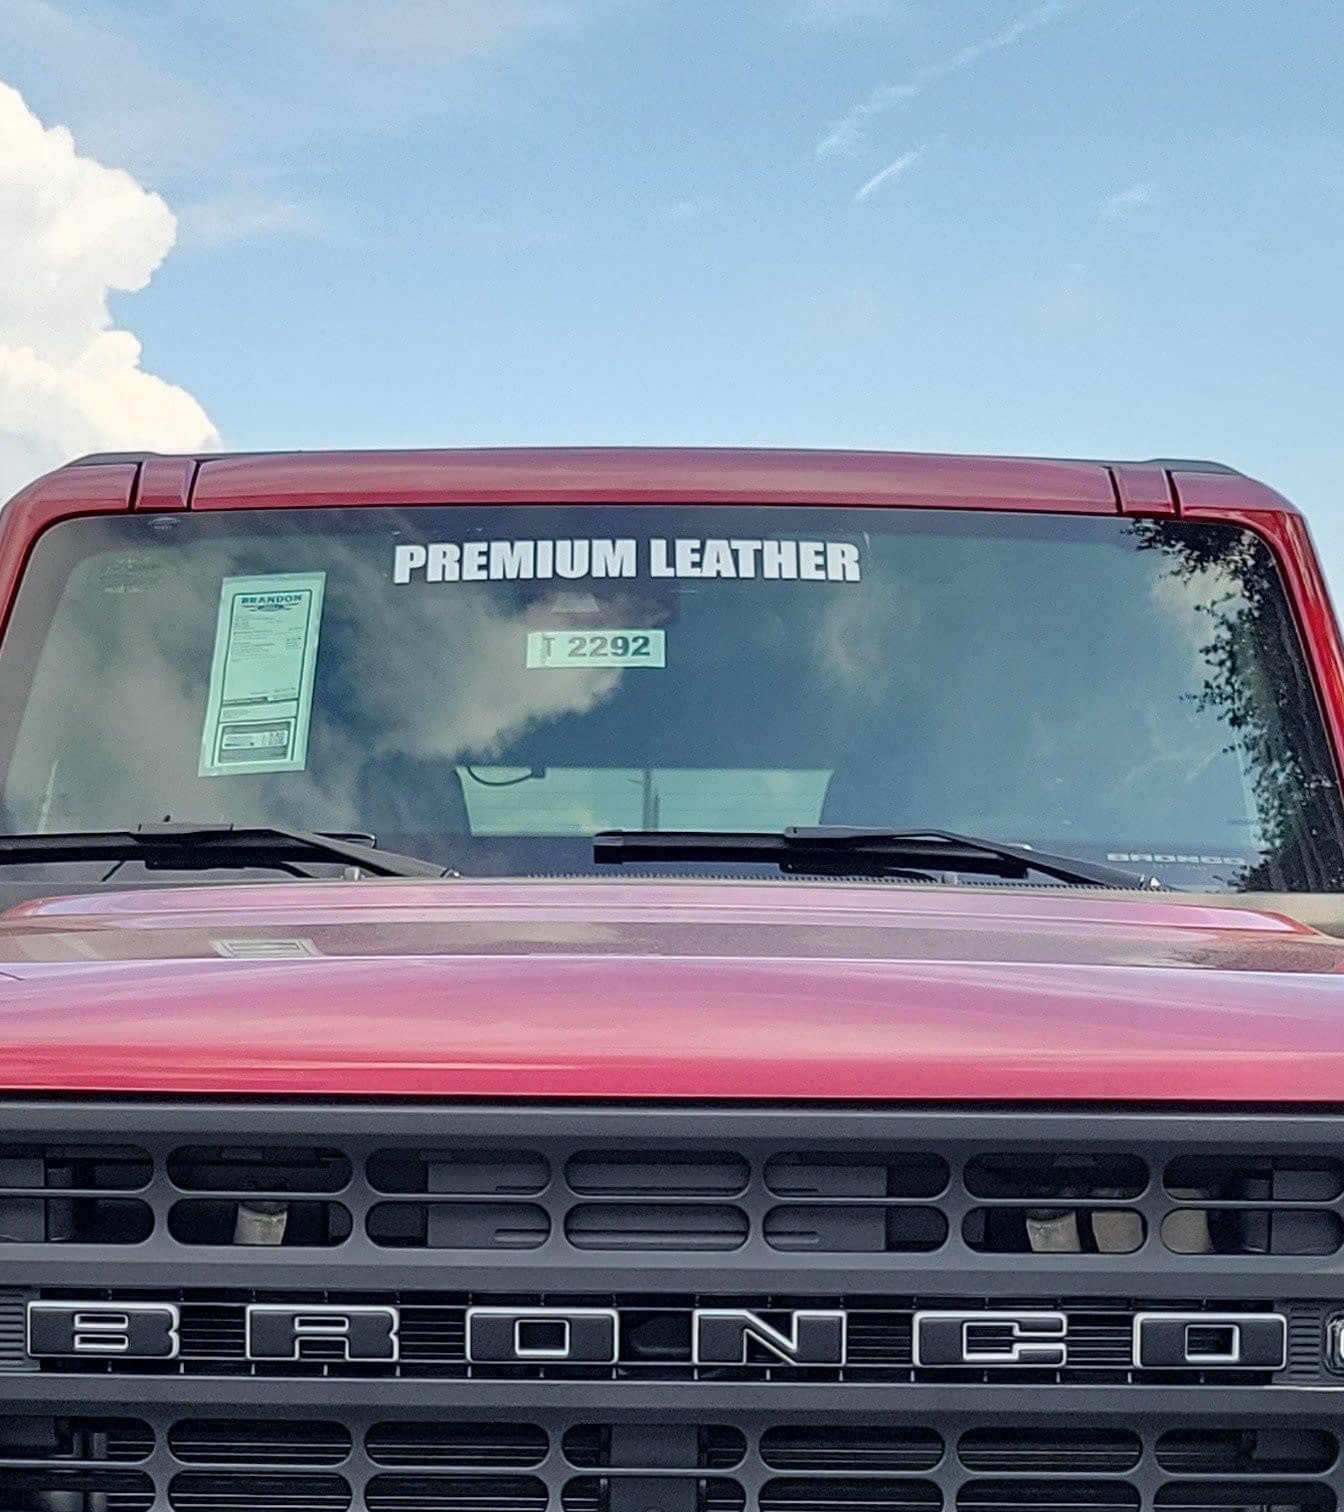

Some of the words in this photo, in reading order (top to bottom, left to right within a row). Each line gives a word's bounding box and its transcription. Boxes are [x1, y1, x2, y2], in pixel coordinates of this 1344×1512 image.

[394, 539, 637, 583] PREMIUM
[650, 539, 861, 581] LEATHER
[241, 594, 302, 604] BRANDON
[568, 636, 651, 657] 2292
[1107, 853, 1246, 865] BRONCO
[28, 1303, 1288, 1369] BRONCO
